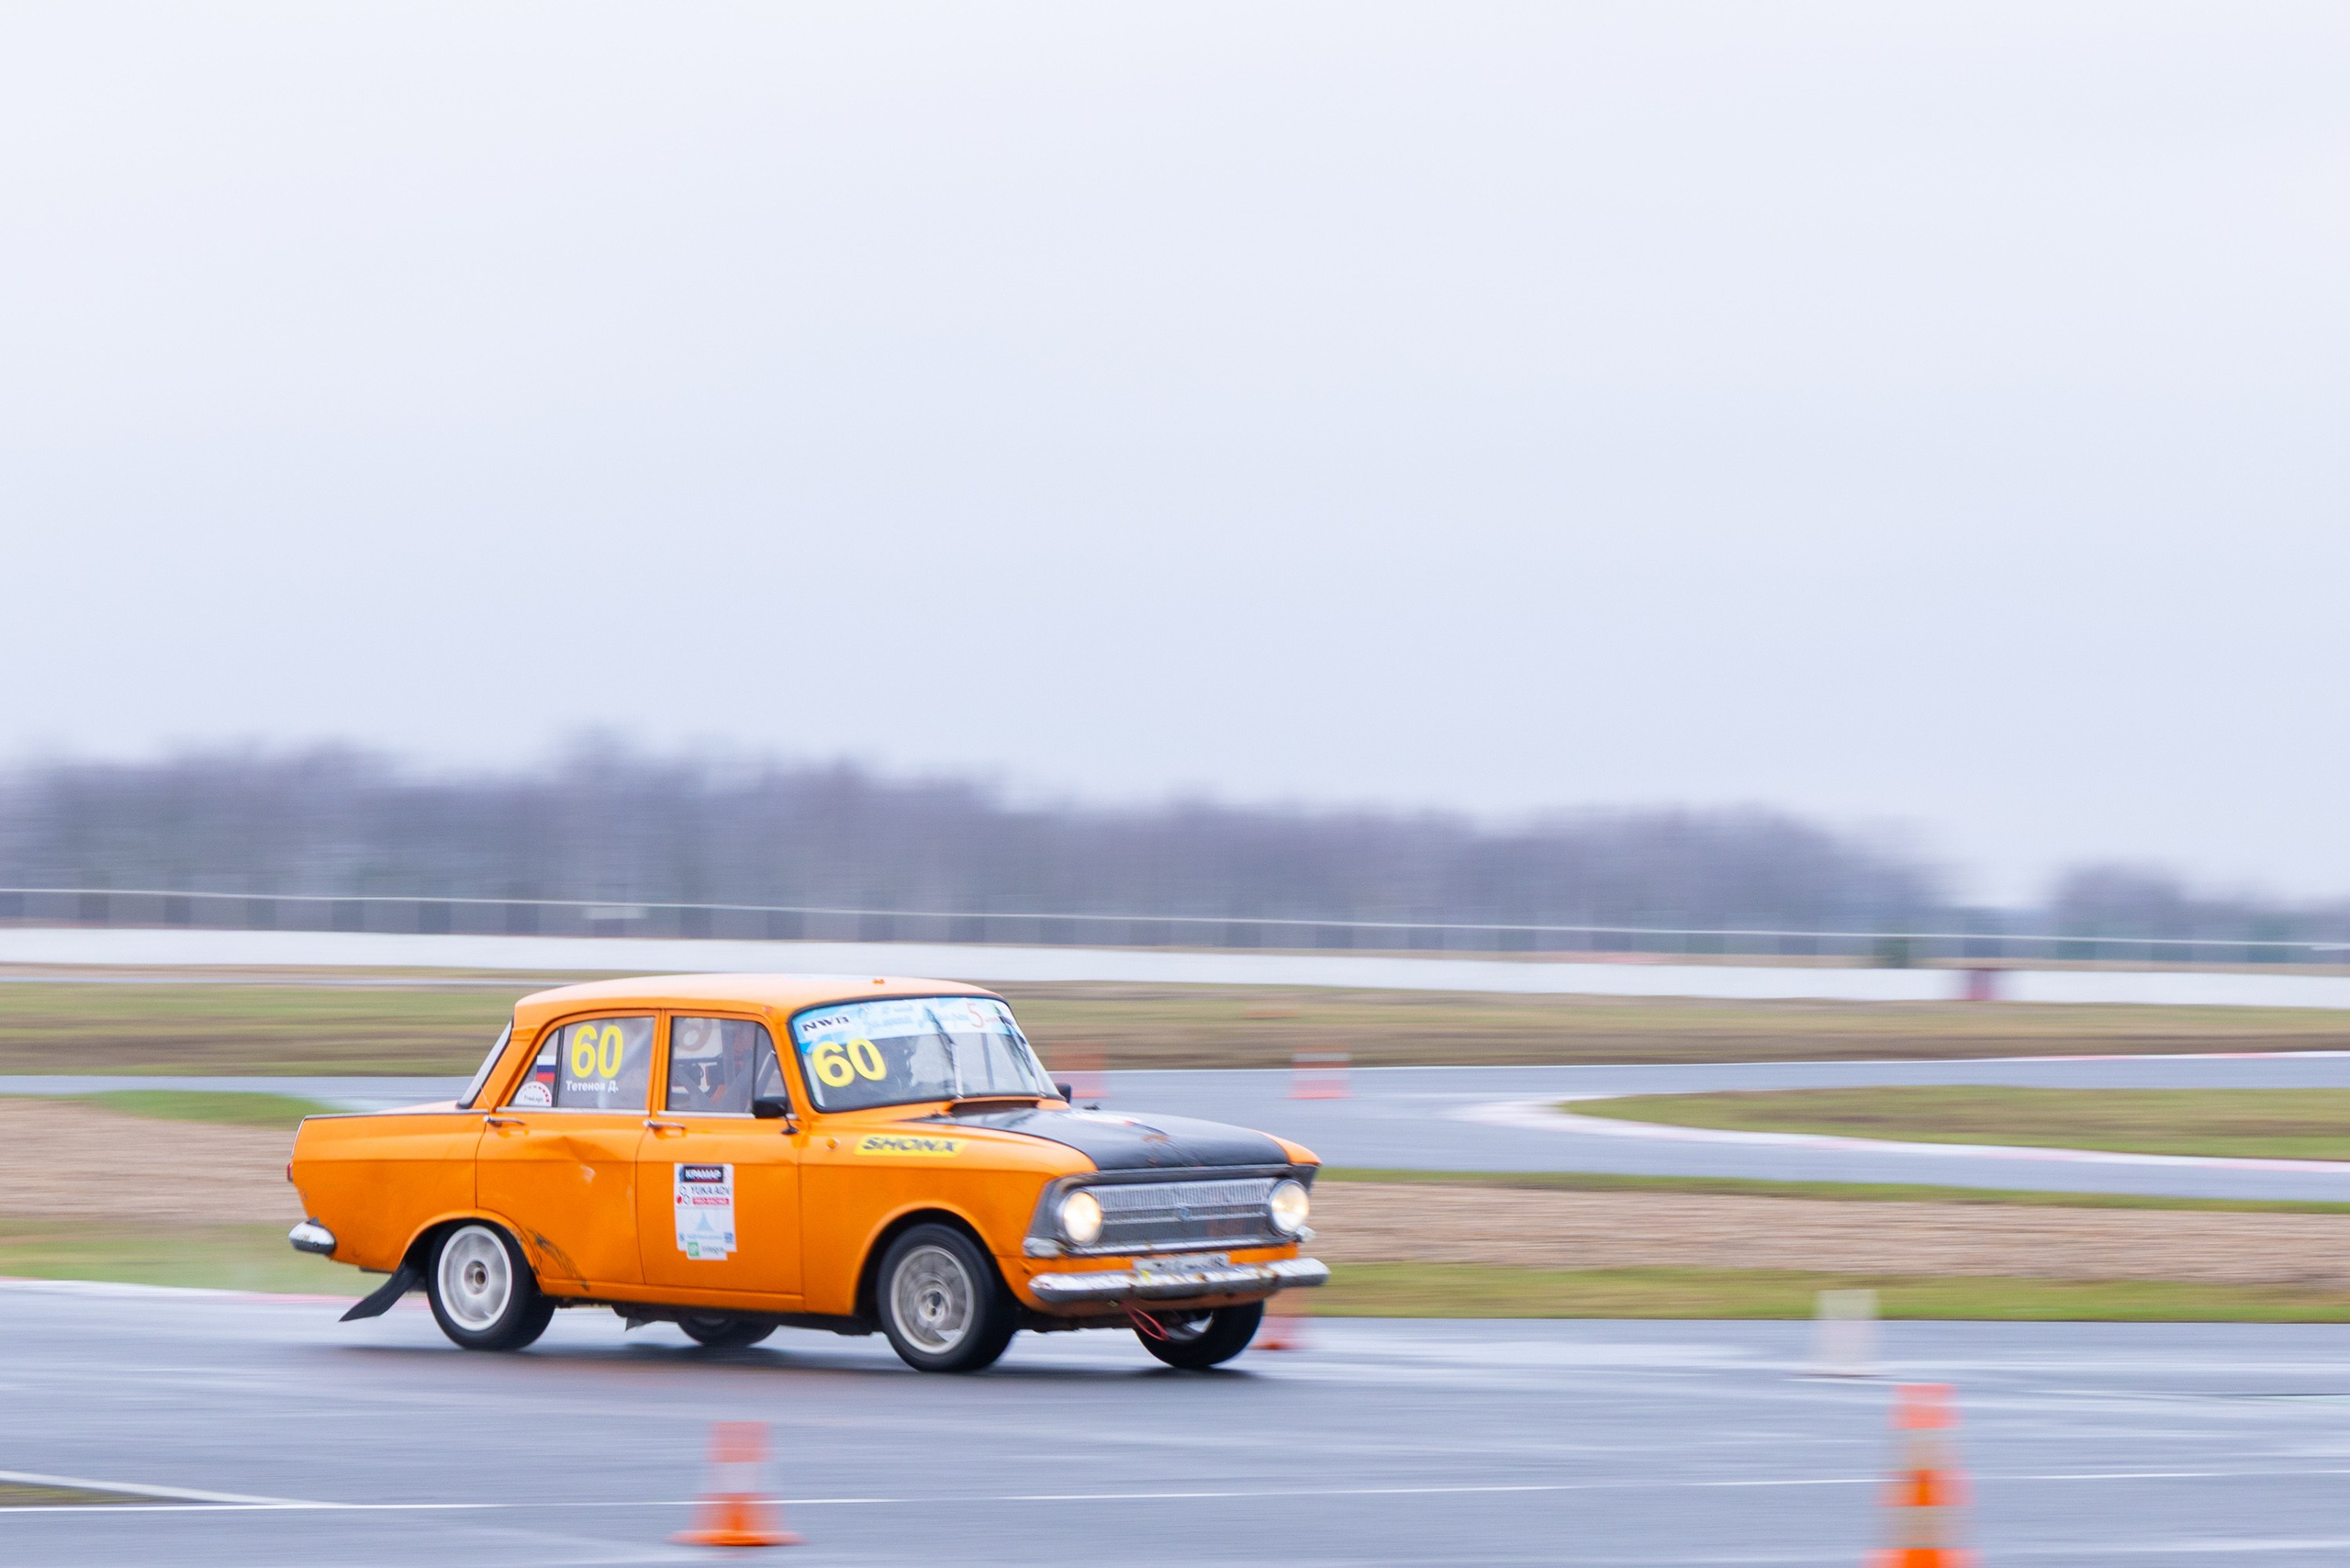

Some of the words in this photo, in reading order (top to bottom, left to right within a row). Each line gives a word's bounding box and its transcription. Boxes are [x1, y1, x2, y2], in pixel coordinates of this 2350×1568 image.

[967, 1002, 984, 1028] 5
[571, 1025, 623, 1079] 60
[811, 1038, 887, 1087] 60
[565, 1080, 606, 1092] Тетенов
[608, 1080, 619, 1092] Д.
